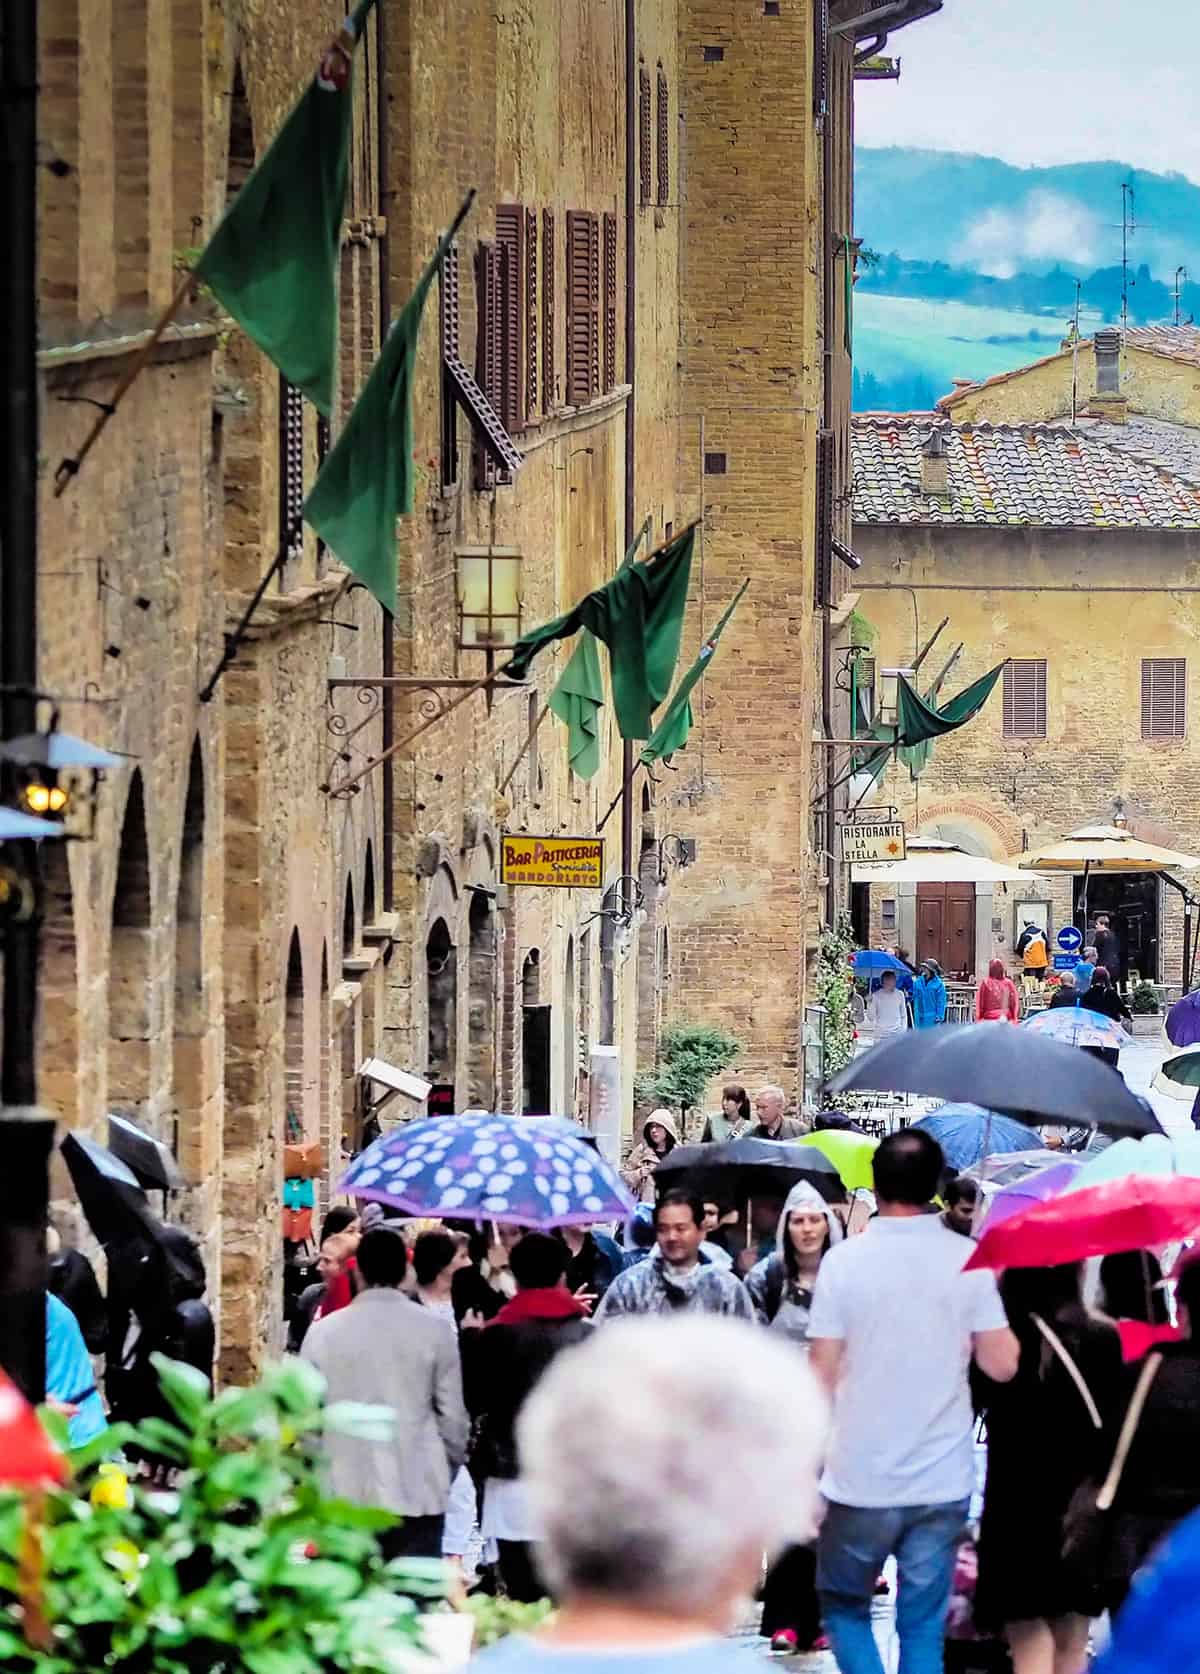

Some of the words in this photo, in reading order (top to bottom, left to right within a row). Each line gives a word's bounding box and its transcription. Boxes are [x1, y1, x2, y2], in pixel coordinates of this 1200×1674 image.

[844, 826, 901, 839] RISTORANTE
[855, 840, 866, 849] LA
[506, 846, 531, 866] BAR
[534, 842, 600, 864] PASTICCERIA
[845, 850, 878, 860] STELLA
[507, 872, 598, 884] MANDORLATO
